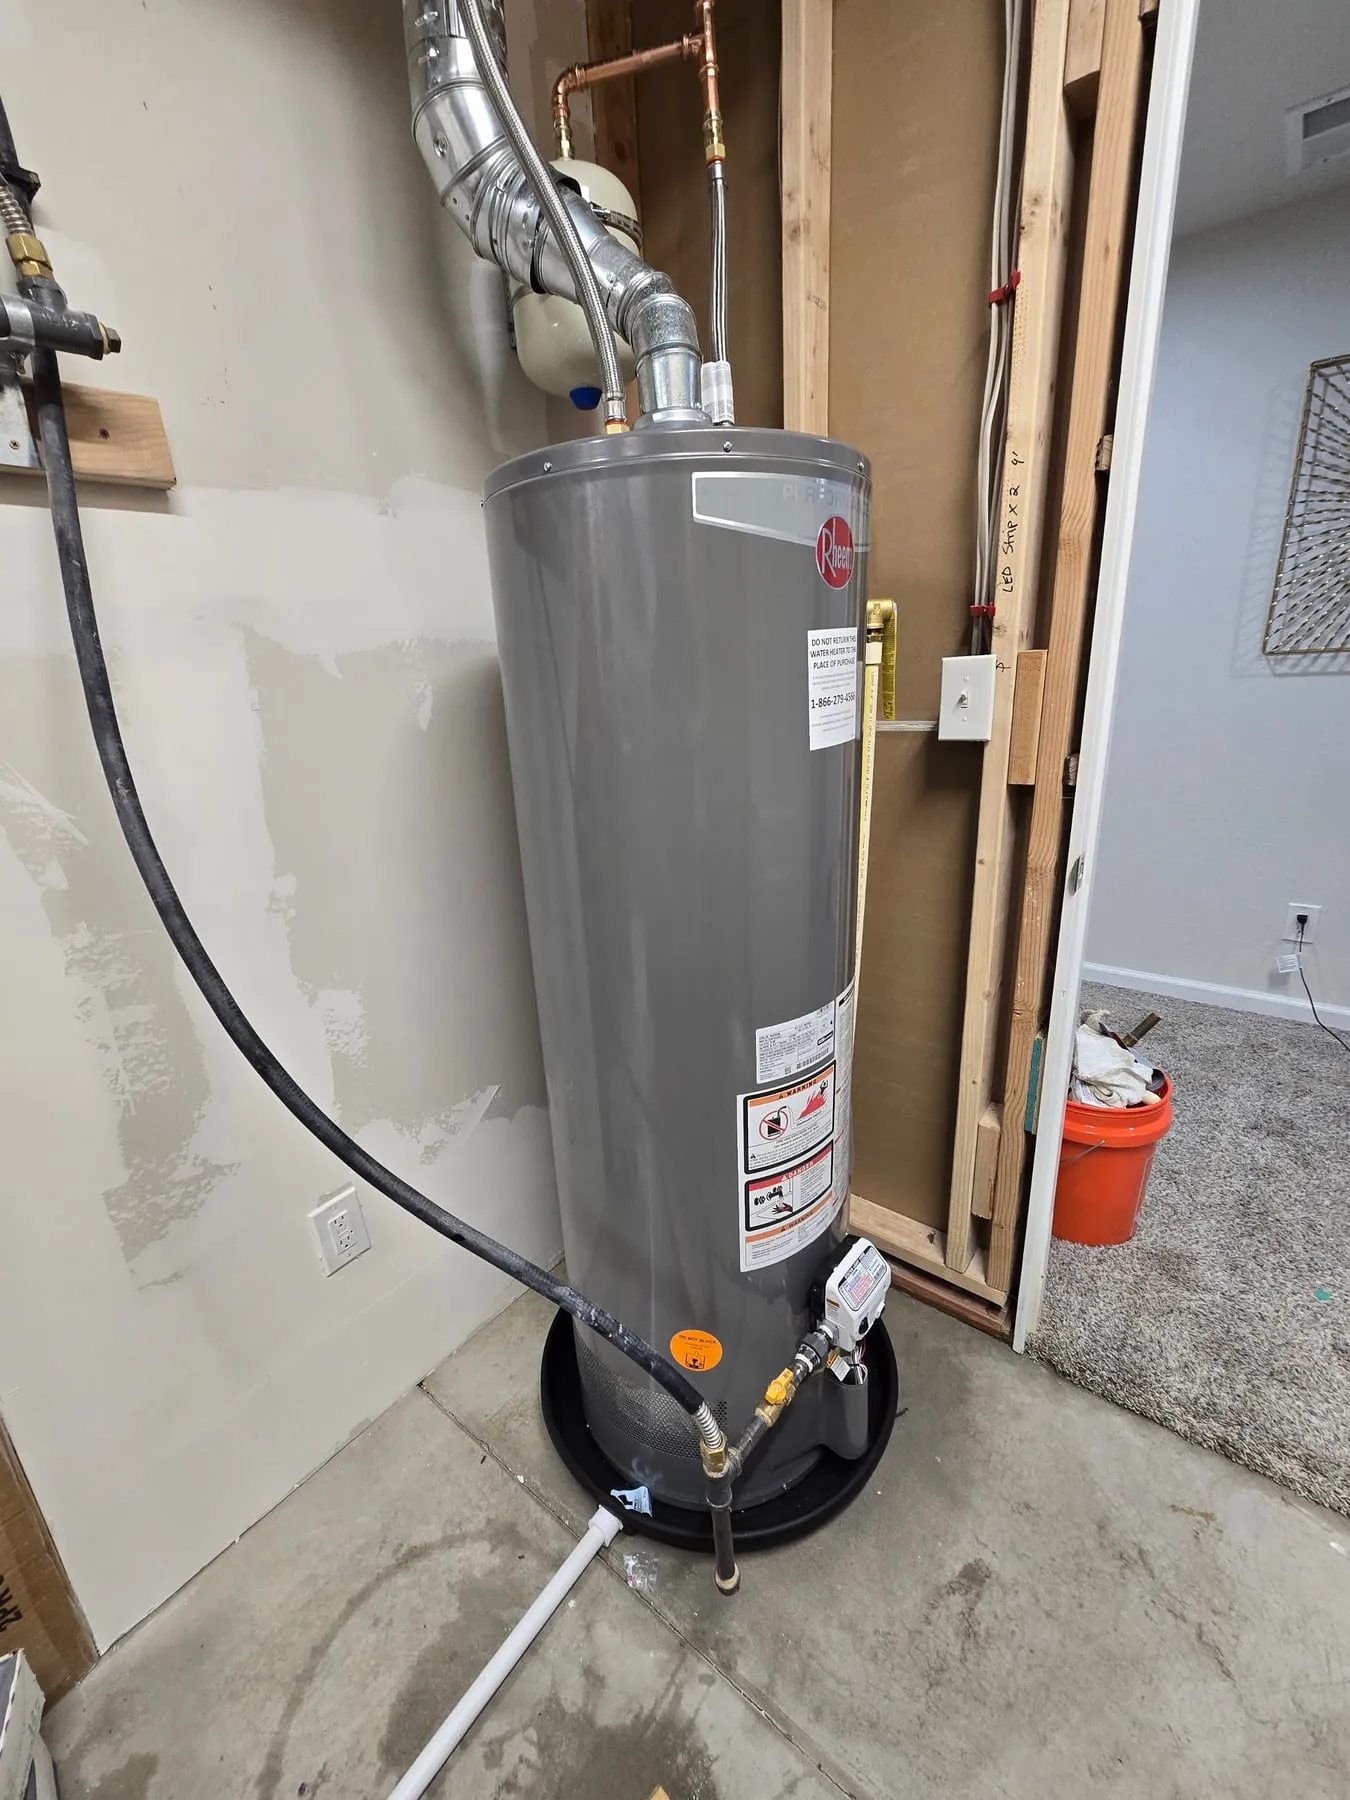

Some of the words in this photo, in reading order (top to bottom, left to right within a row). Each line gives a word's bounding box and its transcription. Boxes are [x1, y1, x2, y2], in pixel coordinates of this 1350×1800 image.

[1009, 484, 1021, 497] 2
[1001, 520, 1018, 555] Strip
[821, 517, 853, 578] Rheem
[1001, 566, 1014, 593] LED
[811, 638, 821, 646] DO
[821, 637, 832, 646] NOT
[810, 648, 830, 659] WATER
[830, 647, 846, 656] HEATER
[813, 660, 830, 670] PLACE
[830, 660, 836, 668] OF
[785, 1078, 817, 1097] WARNING
[788, 1161, 814, 1178] DANGER
[788, 1210, 814, 1229] WARNING
